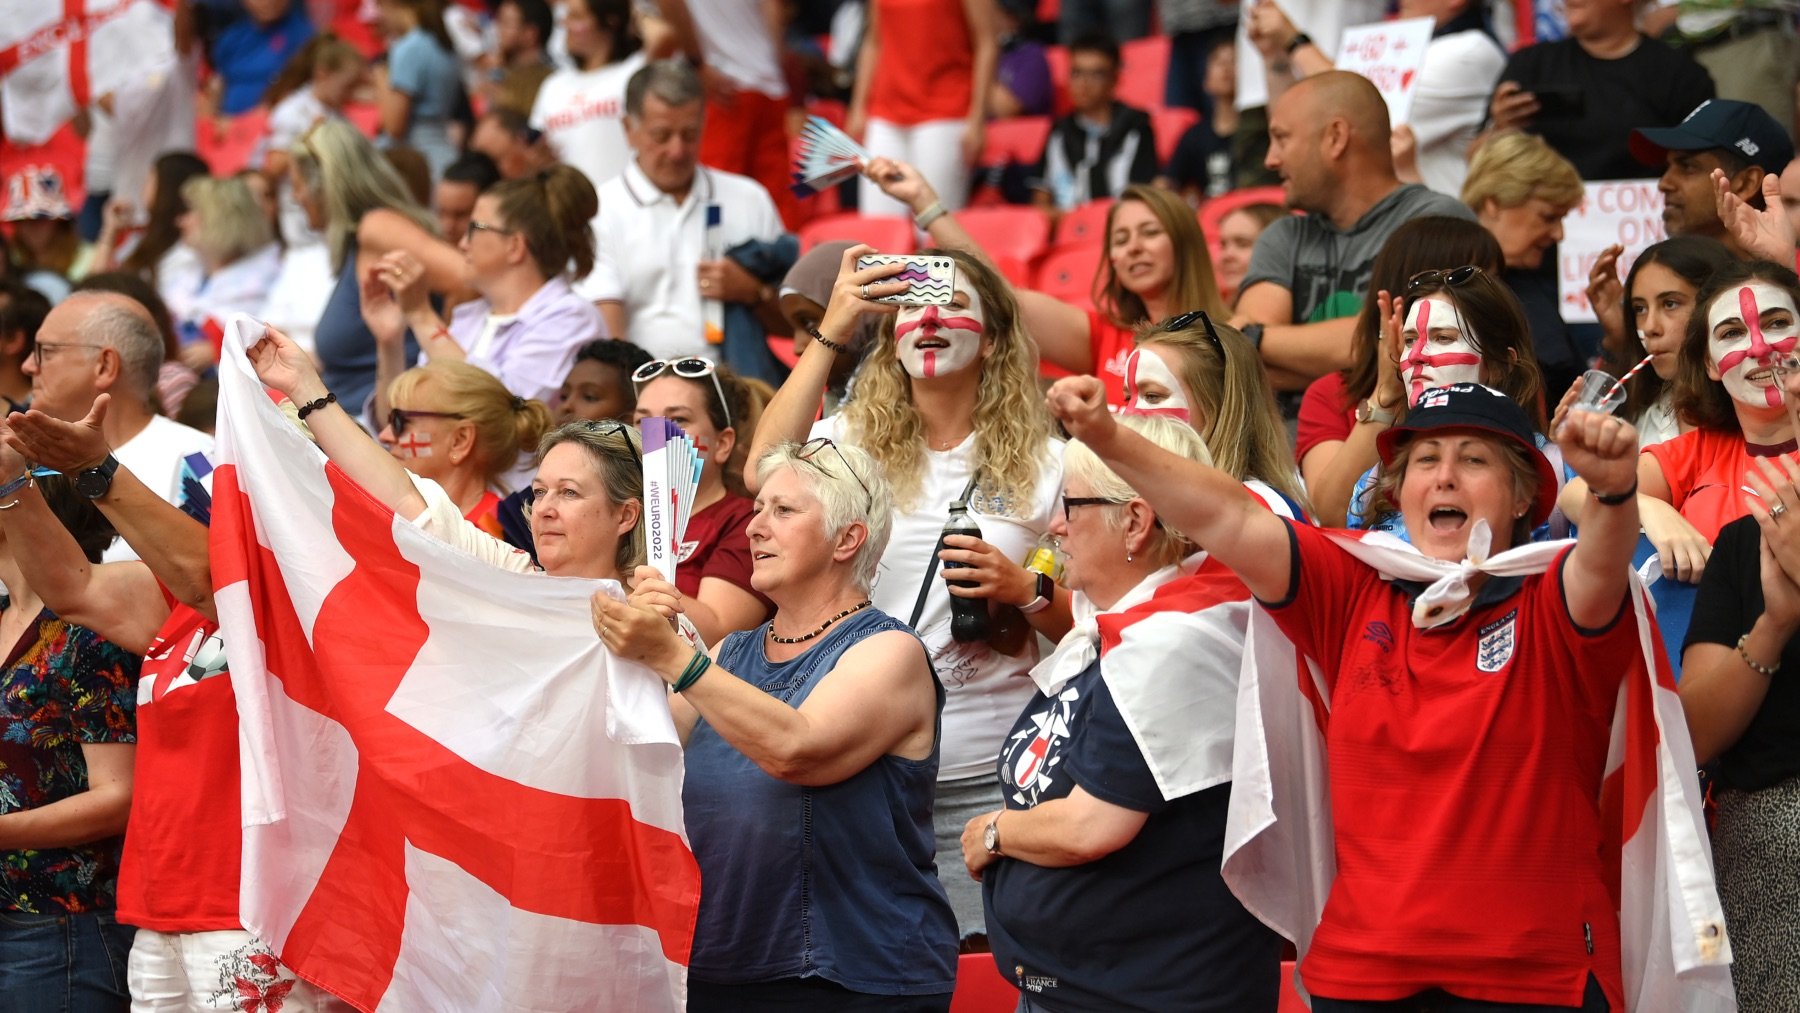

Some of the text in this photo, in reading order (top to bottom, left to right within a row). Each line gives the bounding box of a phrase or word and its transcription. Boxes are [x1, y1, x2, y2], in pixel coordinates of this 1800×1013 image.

[1598, 184, 1666, 213] COM
[1618, 216, 1667, 246] ON
[649, 480, 663, 560] #WEURO2022
[1480, 610, 1517, 635] ENGLAND
[1025, 978, 1058, 988] FRANCE
[1026, 983, 1043, 993] 2019
